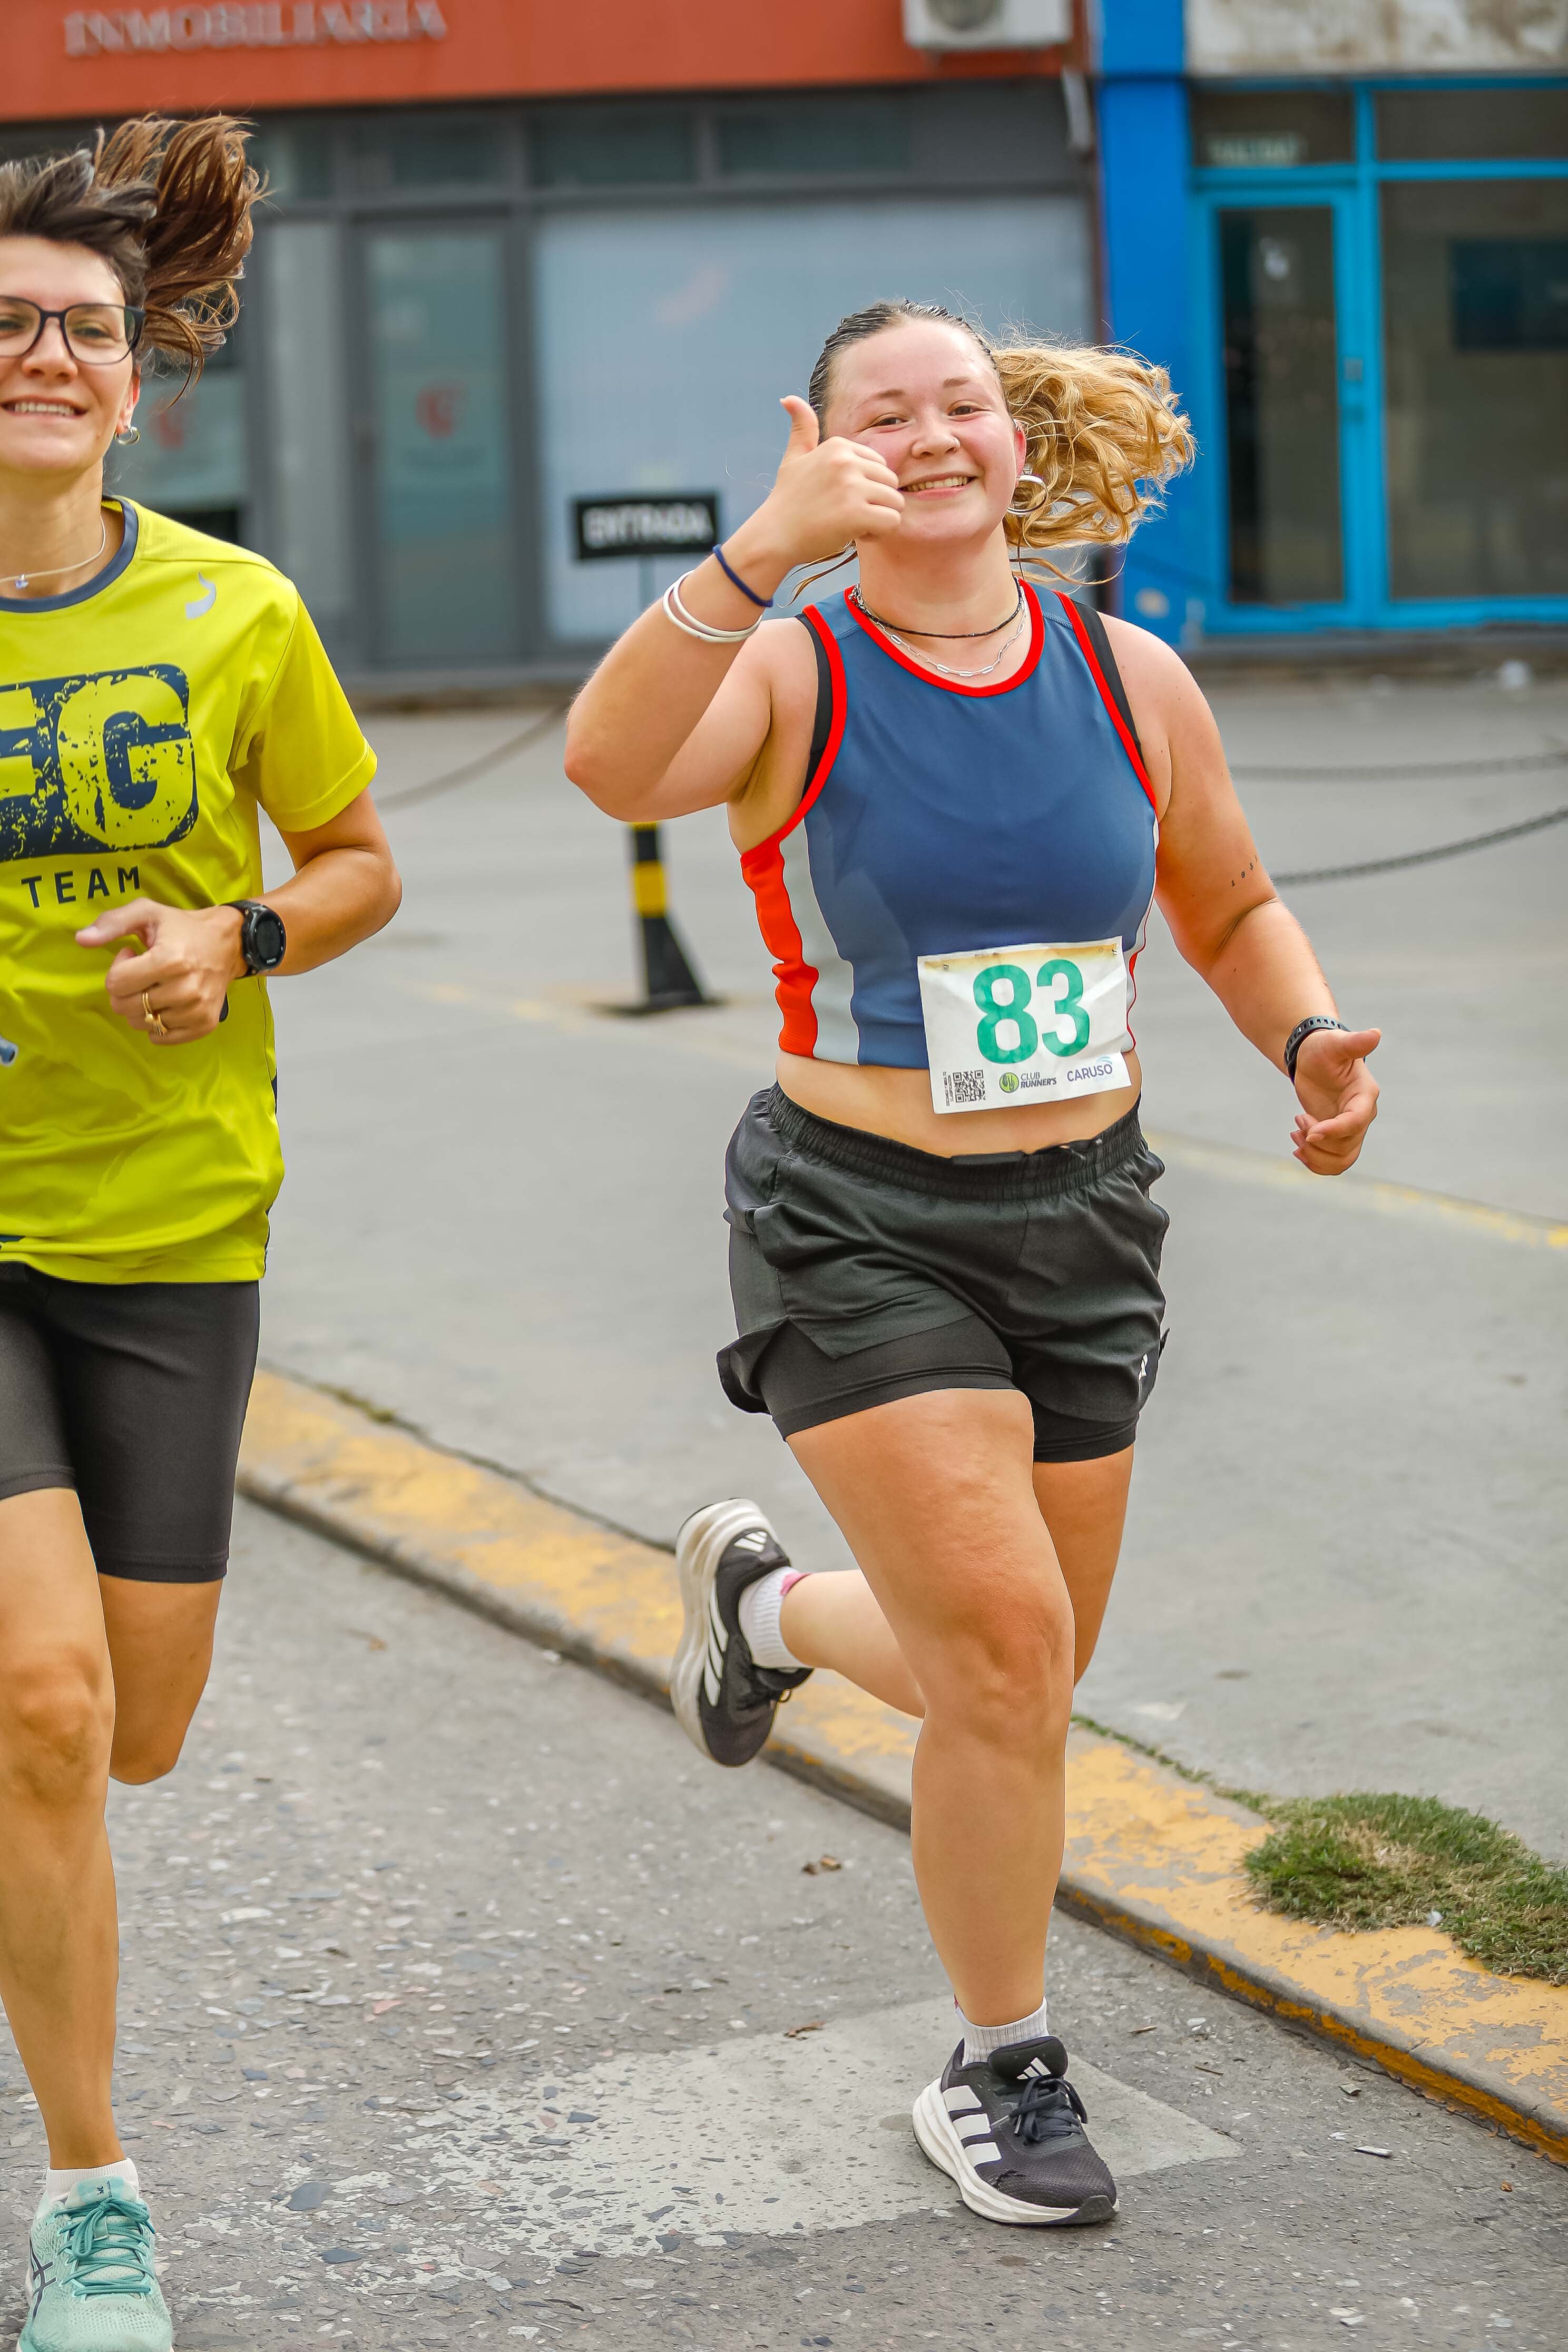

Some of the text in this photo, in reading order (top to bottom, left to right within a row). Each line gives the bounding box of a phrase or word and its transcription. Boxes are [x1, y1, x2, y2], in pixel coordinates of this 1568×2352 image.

[64, 0, 448, 57] INMOBILIARIA
[21, 865, 141, 909] TEAM
[973, 959, 1090, 1064] 83
[1021, 1072, 1040, 1081] CLUB
[1021, 1077, 1057, 1089] RUNNER'S
[1067, 1064, 1113, 1082] CARUSO
